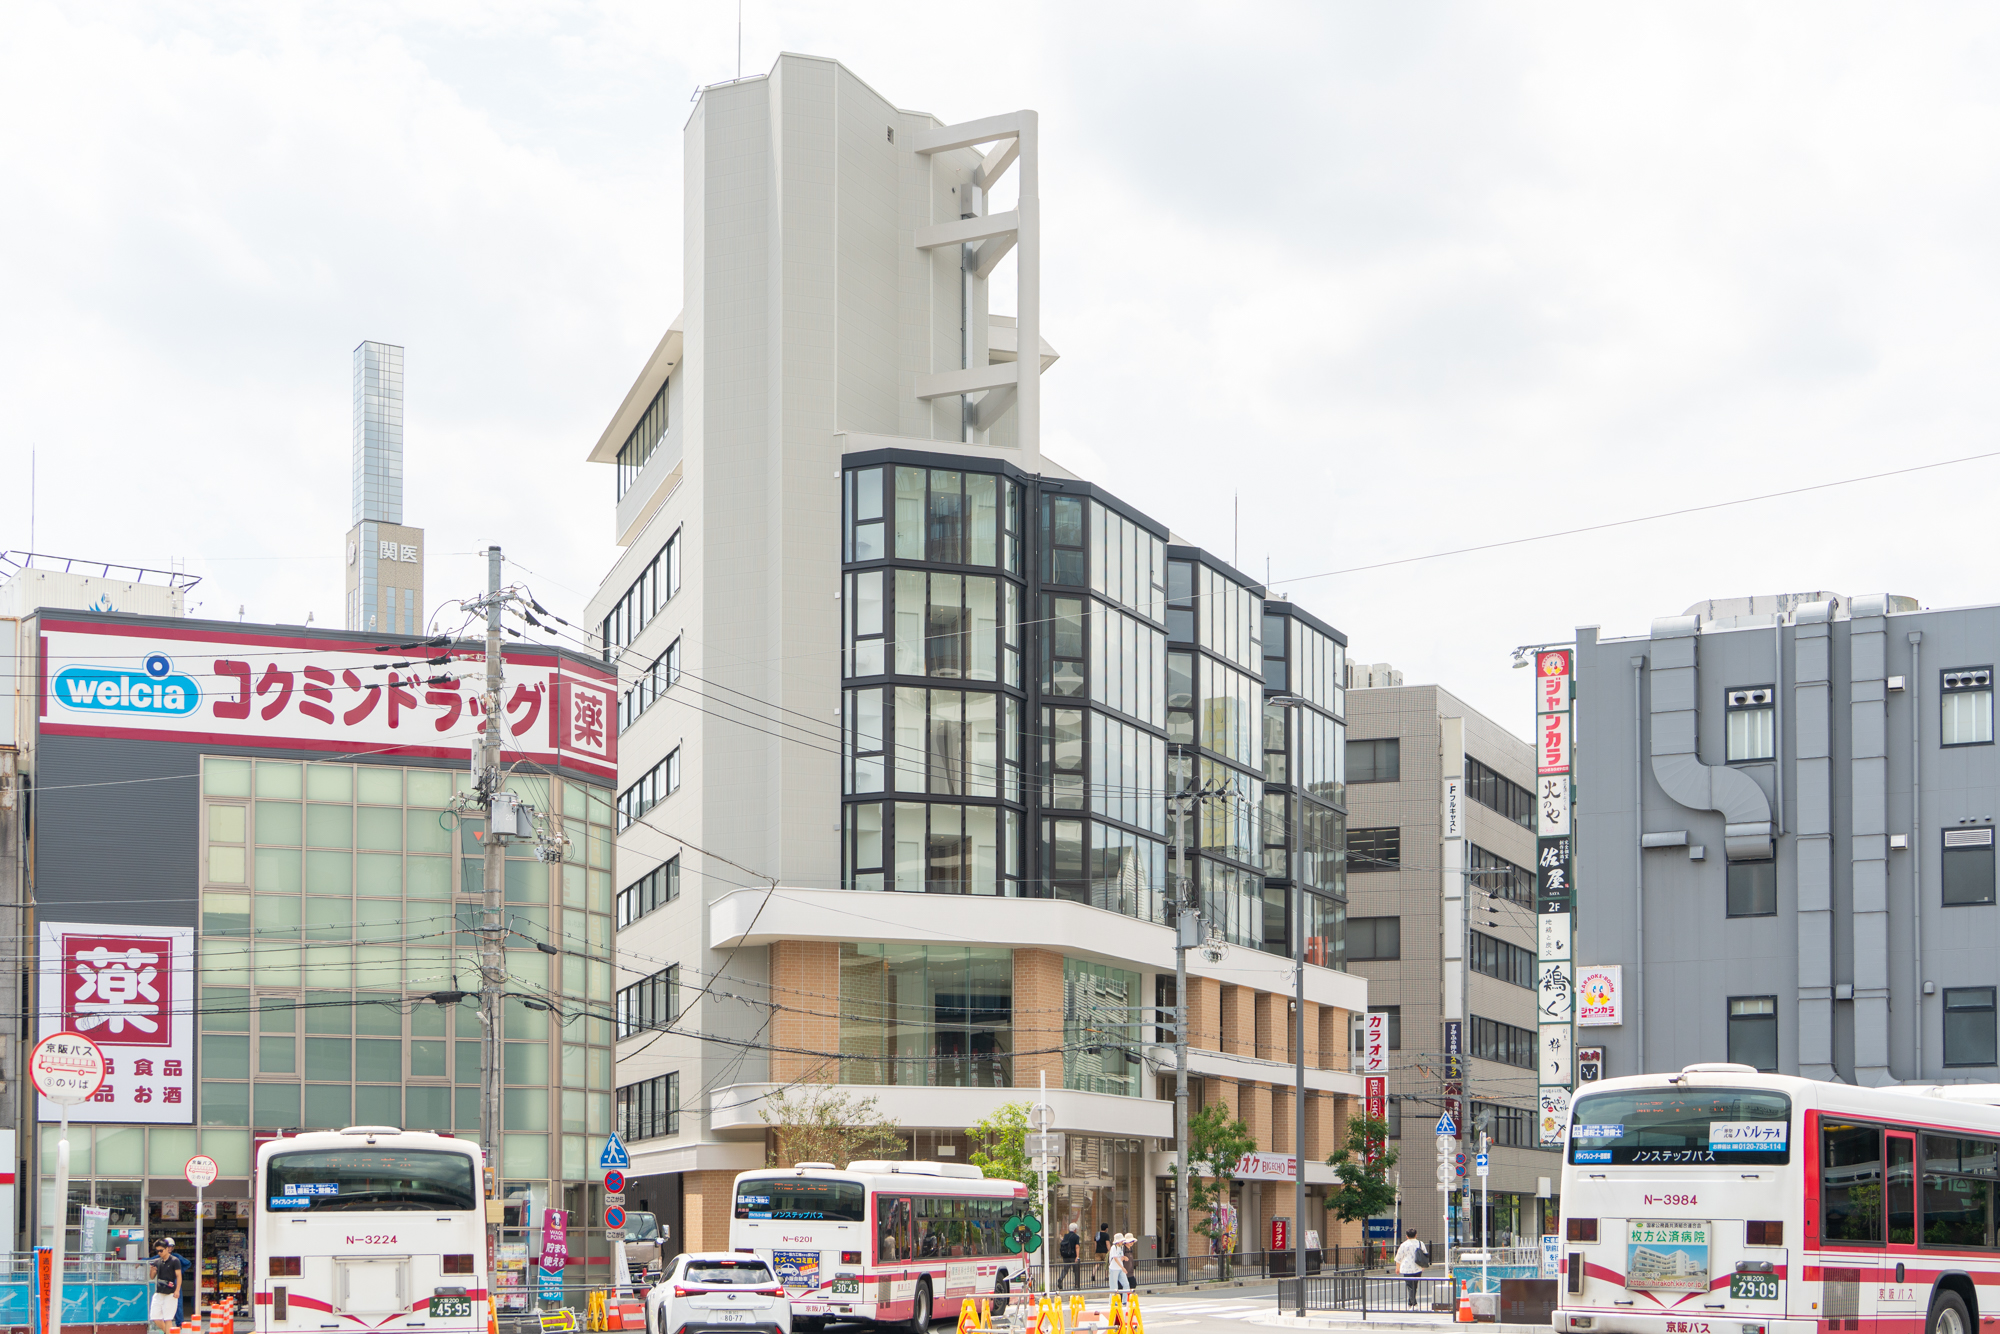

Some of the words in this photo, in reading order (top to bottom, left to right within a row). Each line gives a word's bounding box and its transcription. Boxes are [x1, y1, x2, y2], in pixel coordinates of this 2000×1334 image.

[379, 540, 418, 563] 関医
[66, 673, 186, 712] welcia
[213, 659, 546, 738] コクミンドラッグ
[574, 691, 604, 749] 薬
[1545, 677, 1562, 766] ジャンカラ
[1542, 779, 1562, 824] 火のや
[1539, 846, 1565, 889] 佐屋
[1548, 902, 1560, 912] 2F
[75, 946, 160, 1034] 薬
[1581, 1005, 1615, 1015] ジャンカラ
[1368, 1015, 1383, 1070] カラオケ
[45, 1043, 93, 1056] 京阪バス
[1579, 1050, 1600, 1062] 焼肉
[133, 1058, 182, 1076] 食品
[133, 1085, 182, 1104] お酒
[1632, 1150, 1715, 1162] ノンステップバス
[1262, 1161, 1272, 1173] BIG
[1272, 1162, 1286, 1175] ECHO
[1644, 1194, 1698, 1205] N-3984
[773, 1211, 824, 1219] ノンステップバス
[346, 1235, 398, 1244] N-3224
[1275, 1221, 1283, 1247] カラオケ
[1631, 1230, 1706, 1243] 枚方公済病院
[545, 1243, 567, 1254] 貯まる
[543, 1256, 565, 1267] 使える
[1630, 1280, 1704, 1288] https://hirakoh.kkr.or.jp/
[1878, 1288, 1914, 1300] 京阪バス
[1666, 1322, 1711, 1334] 京阪バス
